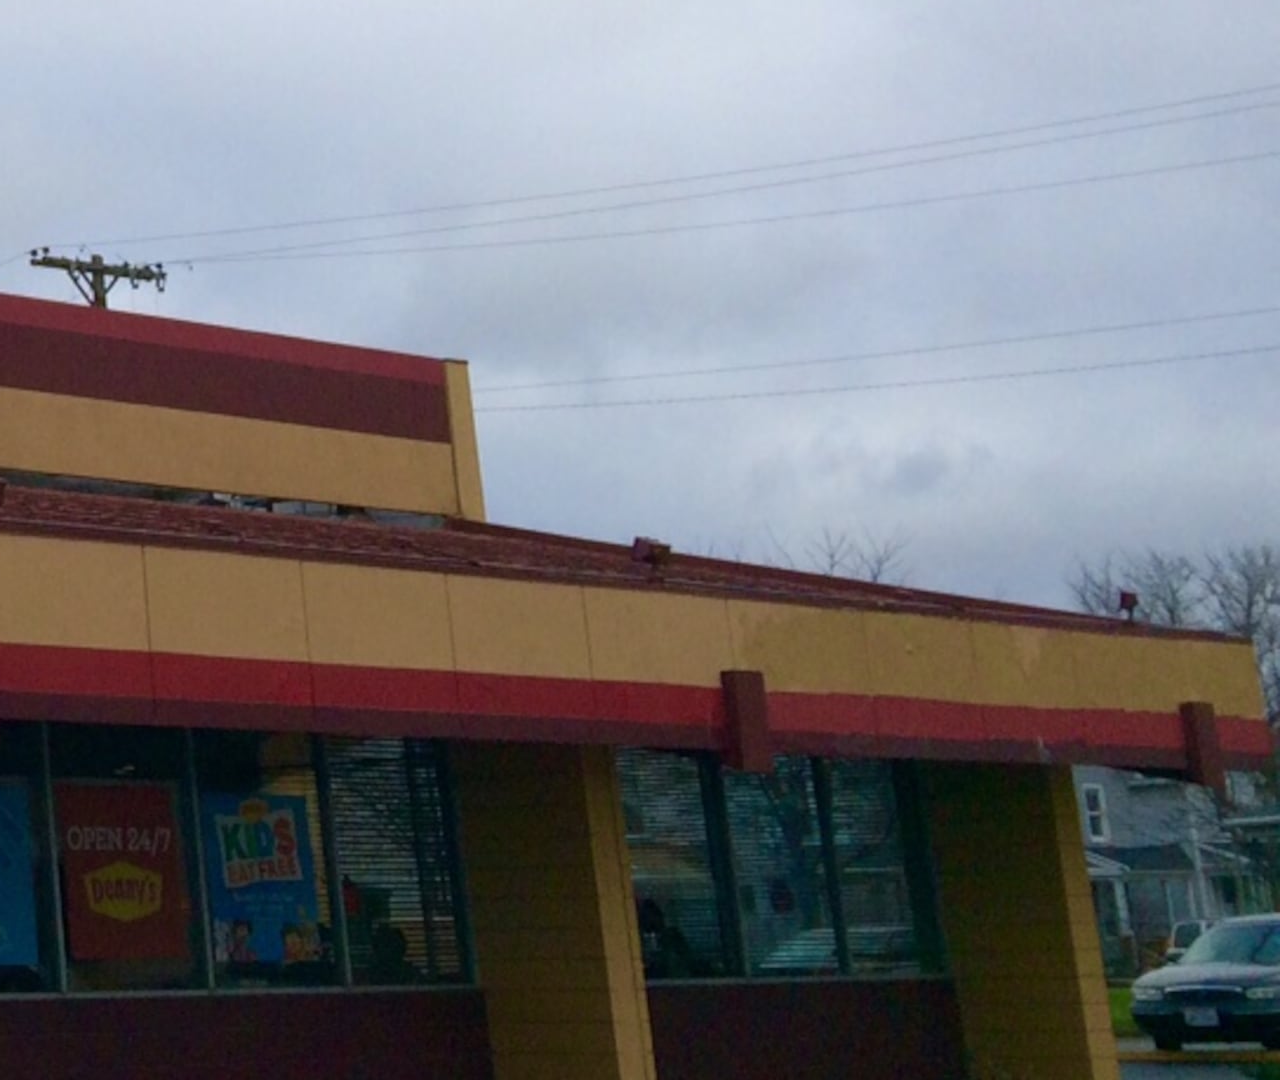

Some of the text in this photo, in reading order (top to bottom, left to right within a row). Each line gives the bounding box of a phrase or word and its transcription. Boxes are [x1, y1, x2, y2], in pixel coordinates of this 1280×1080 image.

[67, 825, 171, 856] OPEN 24/7
[221, 816, 296, 862] KIDS
[91, 874, 158, 905] Denny's
